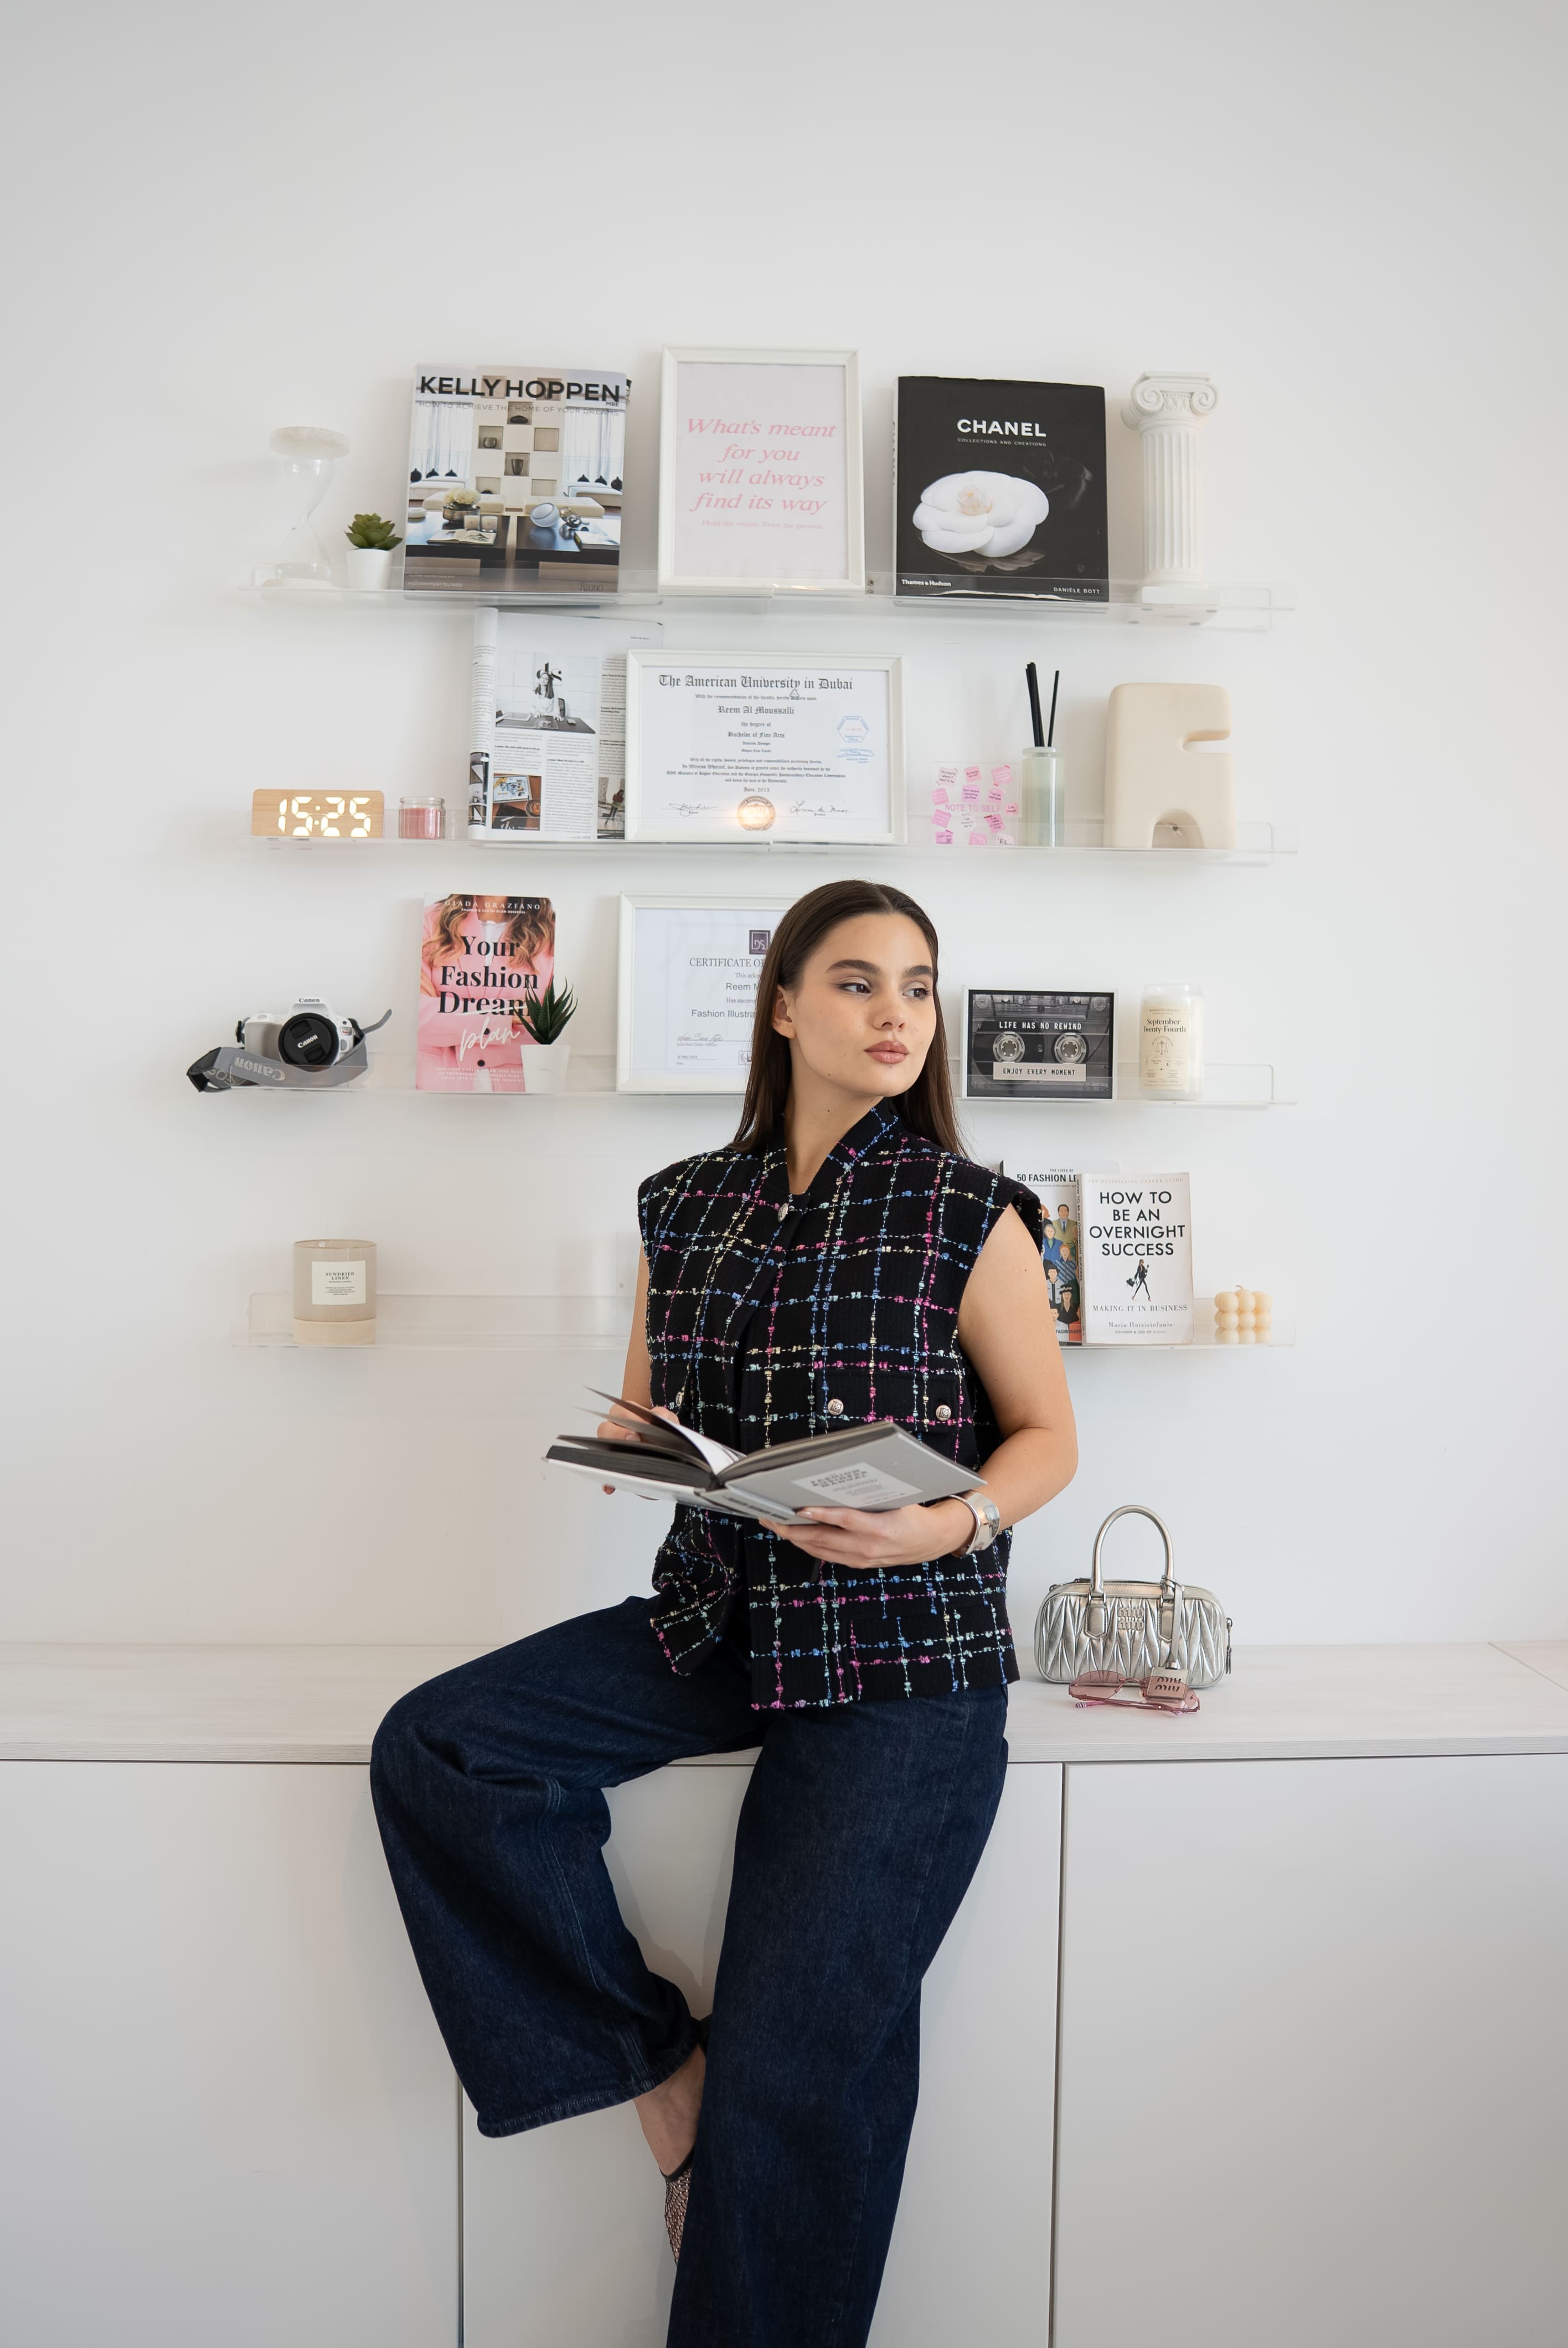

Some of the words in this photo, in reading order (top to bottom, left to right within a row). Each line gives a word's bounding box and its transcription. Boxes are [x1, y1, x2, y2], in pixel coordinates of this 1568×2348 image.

[421, 376, 501, 397] KELLY
[506, 380, 620, 402] HOPPEN
[688, 418, 762, 435] What's
[768, 424, 838, 437] meant
[957, 419, 1046, 437] CHANEL
[717, 444, 755, 462] for
[757, 449, 800, 464] you
[699, 469, 744, 483] will
[749, 470, 824, 490] always
[689, 492, 743, 512] find
[749, 495, 773, 509] its
[782, 499, 827, 515] way
[658, 674, 681, 688] The
[685, 675, 737, 687] American
[741, 676, 801, 689] University
[804, 677, 814, 689] in
[818, 678, 853, 689] Dubai
[755, 706, 795, 714] Moussalli
[278, 796, 371, 837] 15:25
[485, 902, 540, 910] GRAZIANO
[460, 936, 520, 957] Your
[689, 958, 751, 967] CERTIFICATE
[440, 966, 539, 989] Fashion
[437, 991, 532, 1017] Dream
[692, 1010, 724, 1018] Fashion
[1147, 1018, 1181, 1026] September
[297, 1034, 318, 1048] Canon
[460, 1017, 520, 1062] plan
[235, 1057, 285, 1080] Canon
[1029, 1174, 1066, 1182] FASHION
[1100, 1192, 1143, 1204] HOW
[1149, 1191, 1172, 1204] TO
[1113, 1209, 1130, 1221] BE
[1136, 1209, 1160, 1221] AN
[1089, 1225, 1185, 1238] OVERNIGHT
[1102, 1243, 1174, 1256] SUCCESS
[1118, 1607, 1144, 1618] miu
[1118, 1621, 1144, 1631] miu
